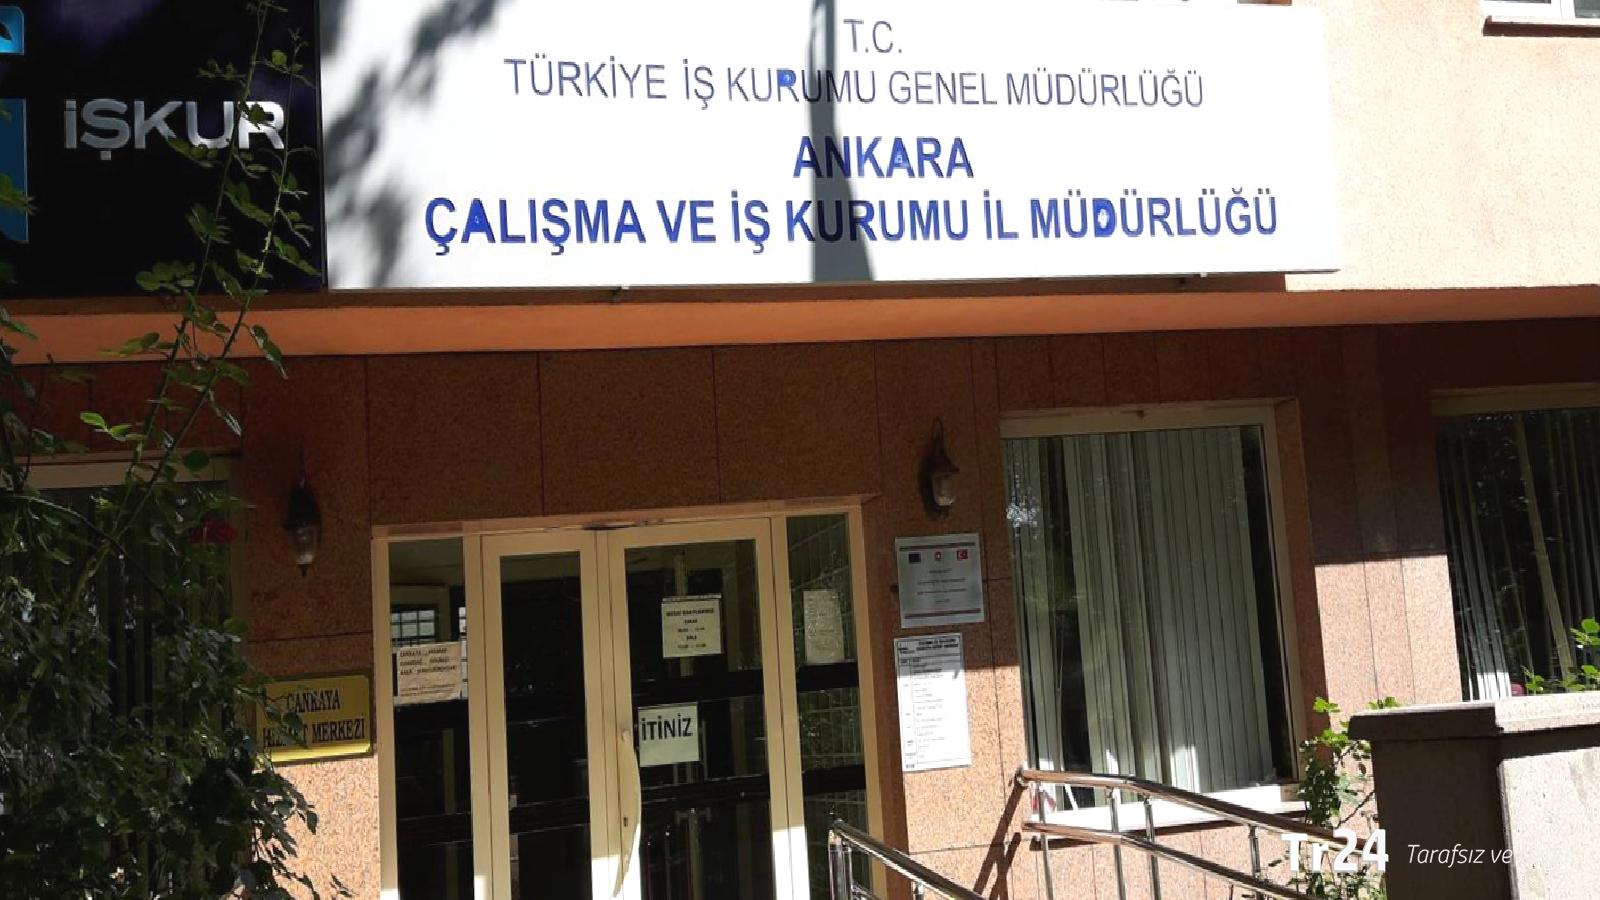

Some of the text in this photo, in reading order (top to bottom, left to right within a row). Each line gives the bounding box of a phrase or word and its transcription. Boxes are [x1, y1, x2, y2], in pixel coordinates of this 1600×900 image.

[843, 18, 902, 53] T.C.
[503, 52, 1204, 111] TÜRKİYE İŞ KURUMU GENEL MÜDÜRLÜĞÜ
[792, 135, 975, 179] ANKARA
[424, 187, 1278, 256] ÇALIŞMA VE İŞ KURUMU İL MÜDÜRLÜĞÜ
[312, 712, 366, 745] MERKEZİ
[641, 713, 694, 741] İTİNİZ
